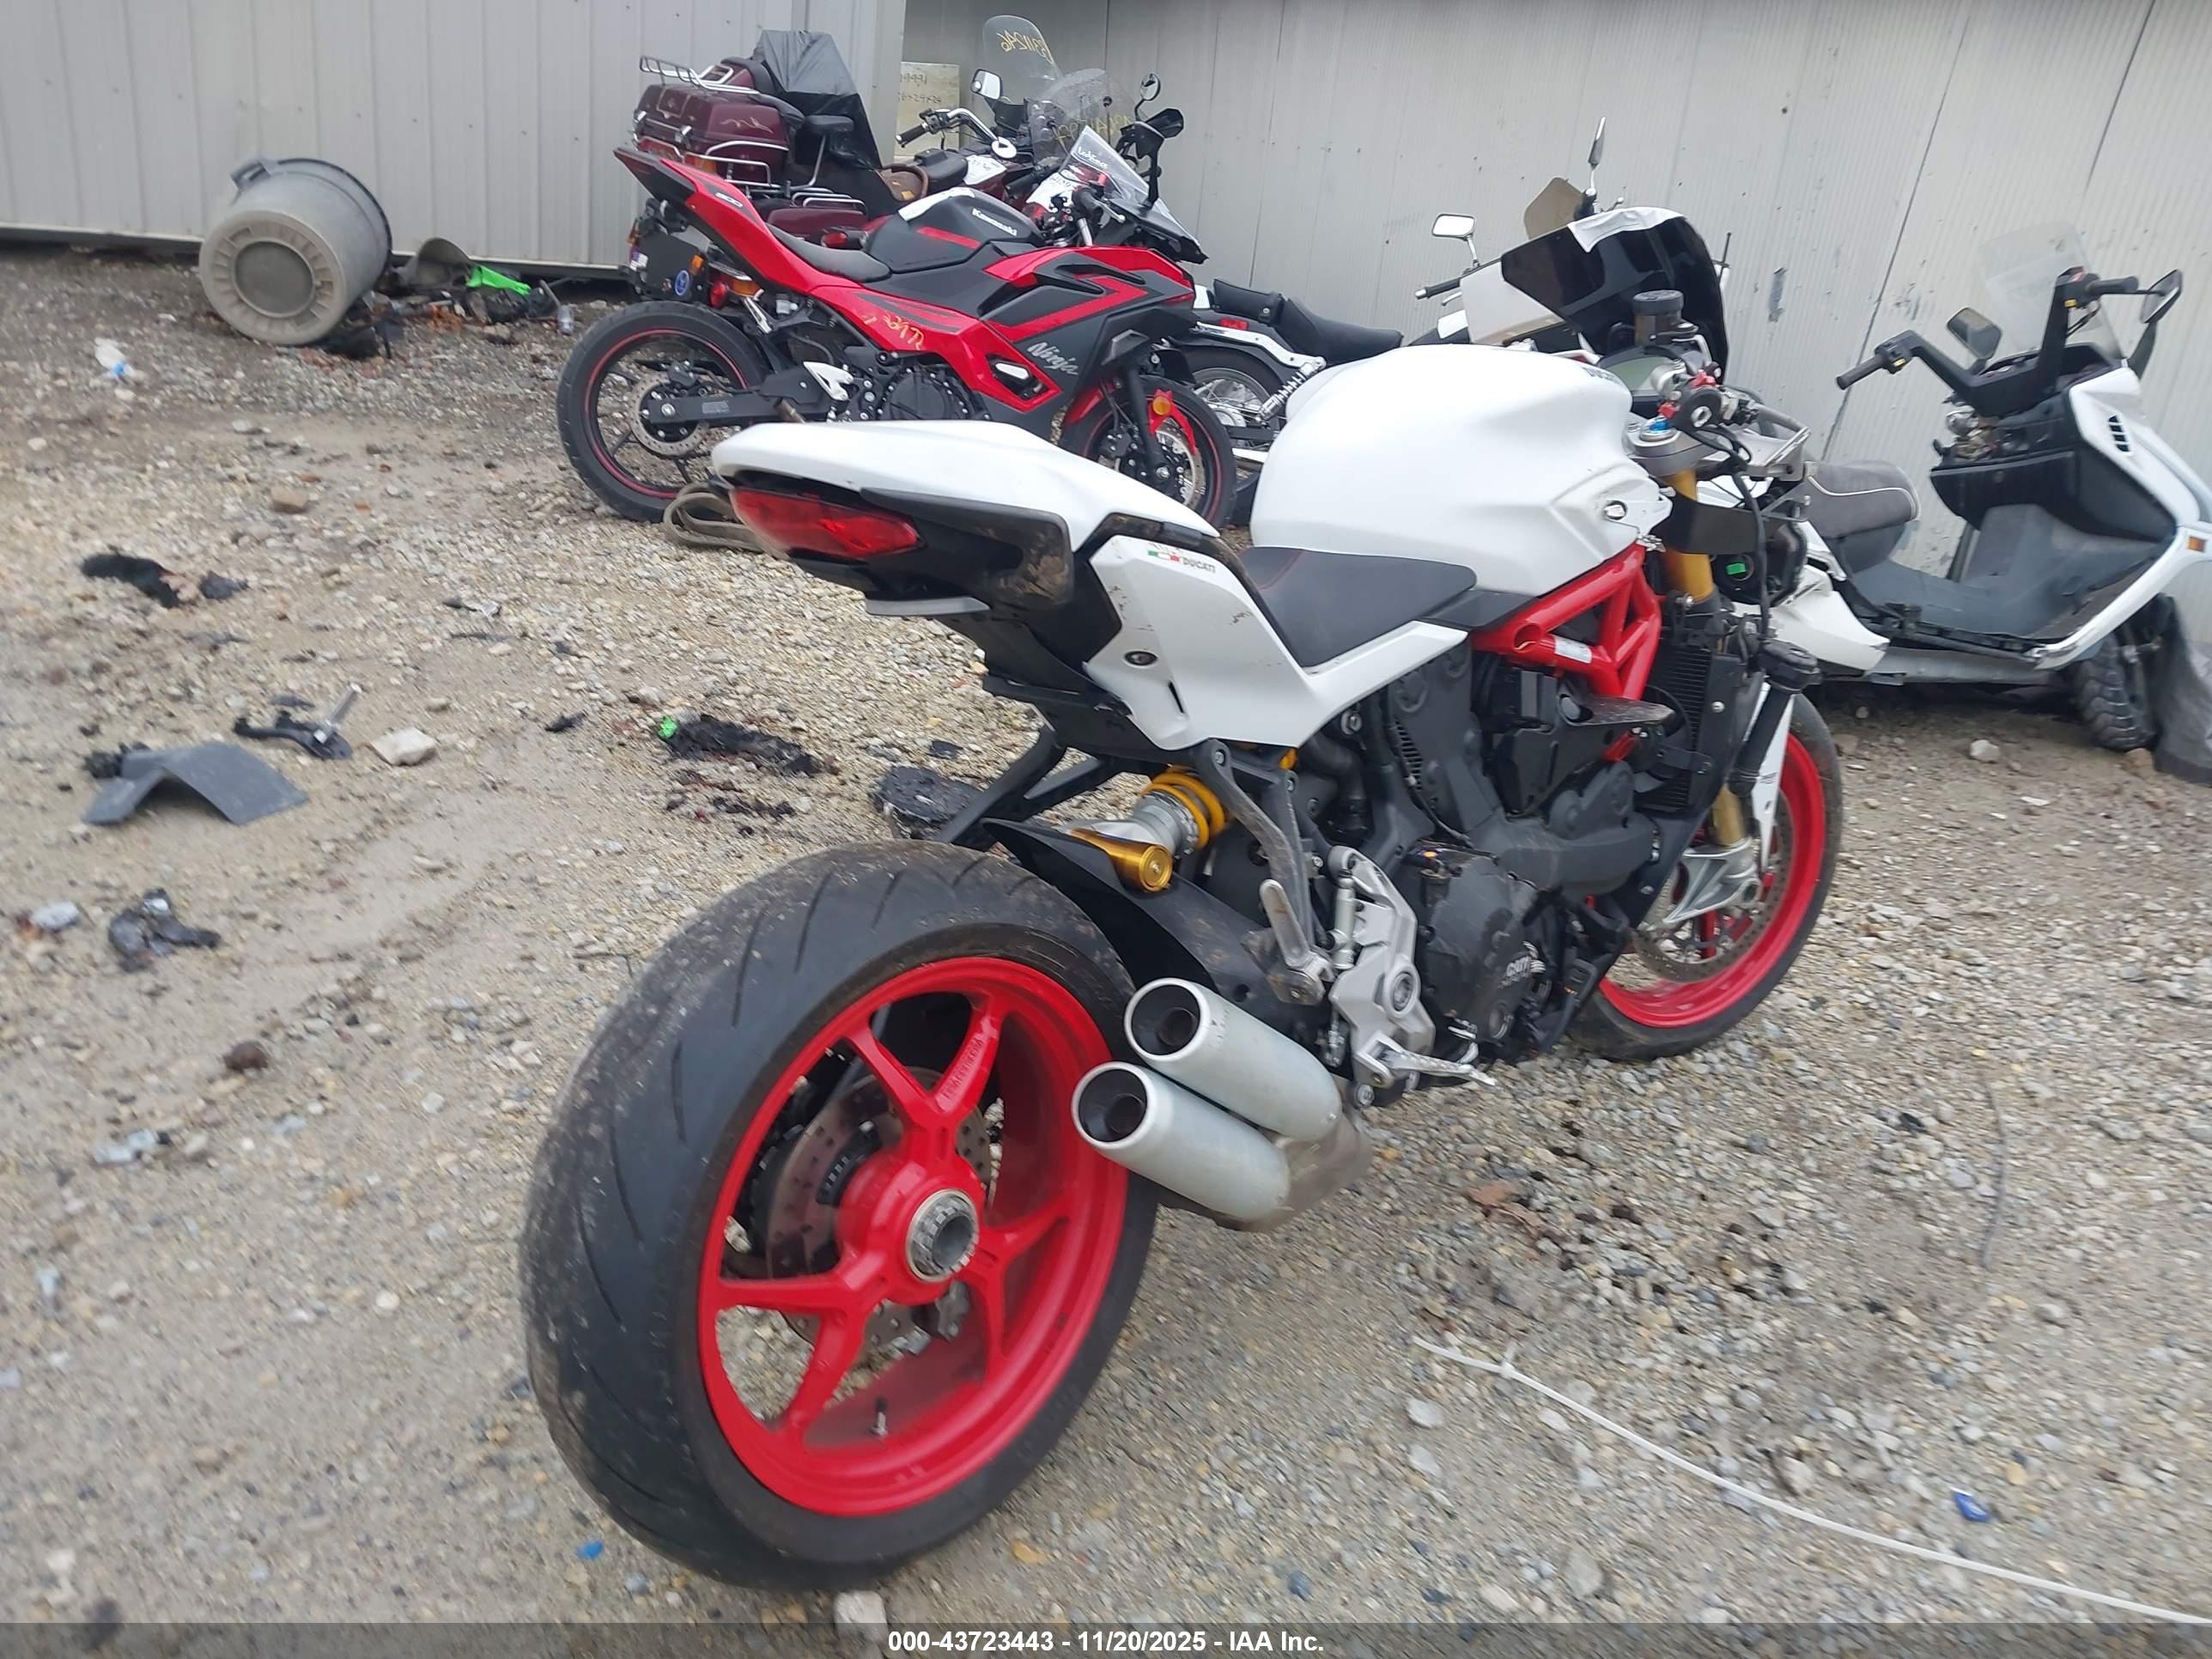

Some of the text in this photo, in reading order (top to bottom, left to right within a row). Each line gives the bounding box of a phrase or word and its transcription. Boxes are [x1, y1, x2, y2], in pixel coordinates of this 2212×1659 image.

[972, 207, 1018, 237] Kawasaki
[1027, 342, 1079, 375] Ninja
[1181, 556, 1216, 574] DUCATI
